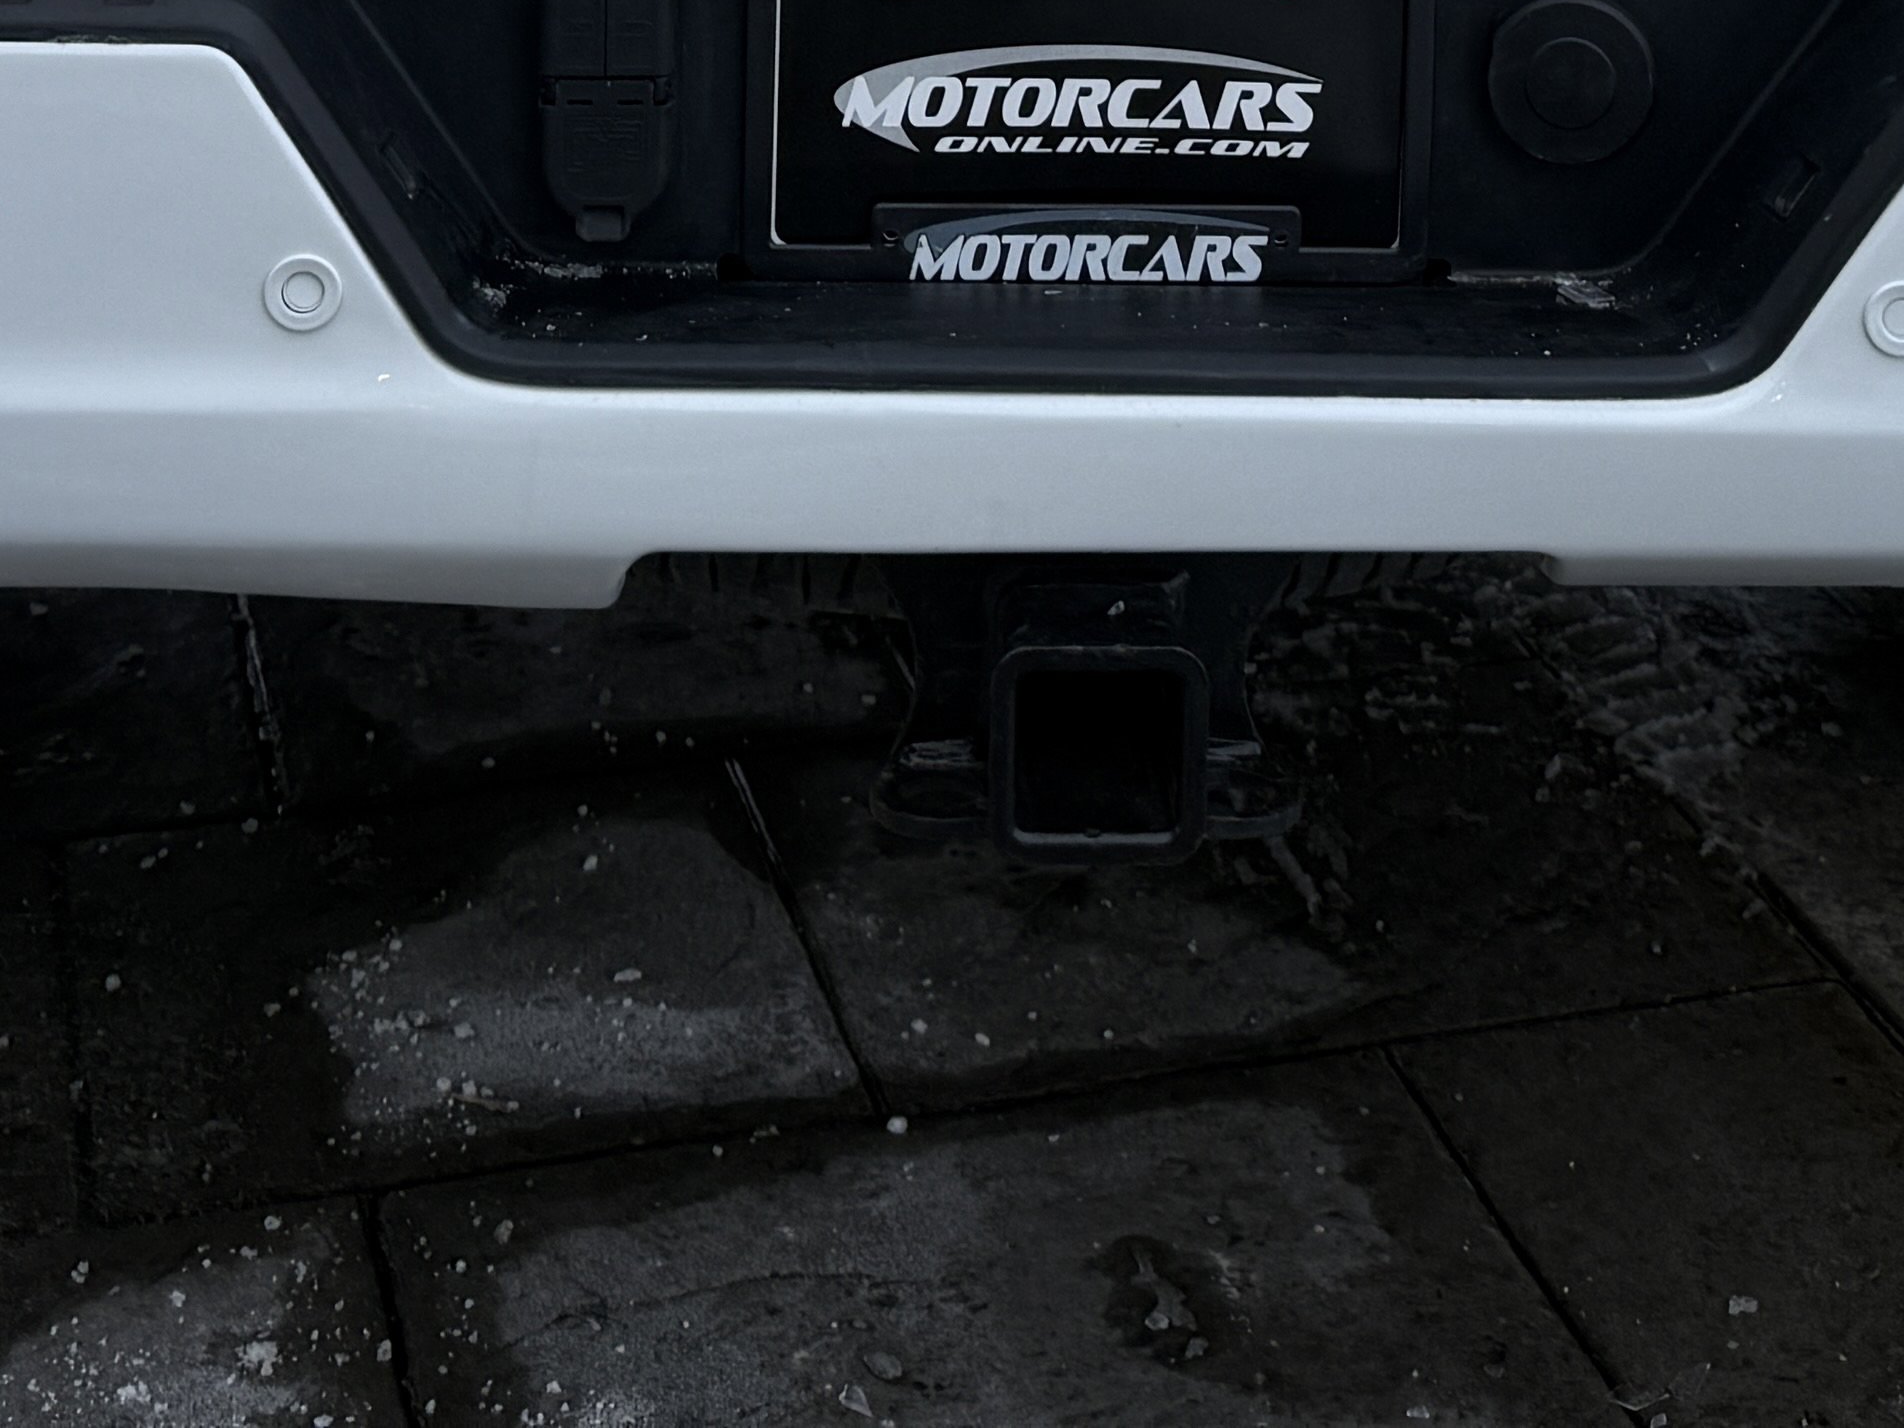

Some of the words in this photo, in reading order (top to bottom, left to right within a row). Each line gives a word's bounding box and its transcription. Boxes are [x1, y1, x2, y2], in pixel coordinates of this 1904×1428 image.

[841, 75, 1324, 133] MOTORCARS
[933, 135, 1310, 159] ONLINE.COM
[908, 233, 1270, 282] MOTORCARS
